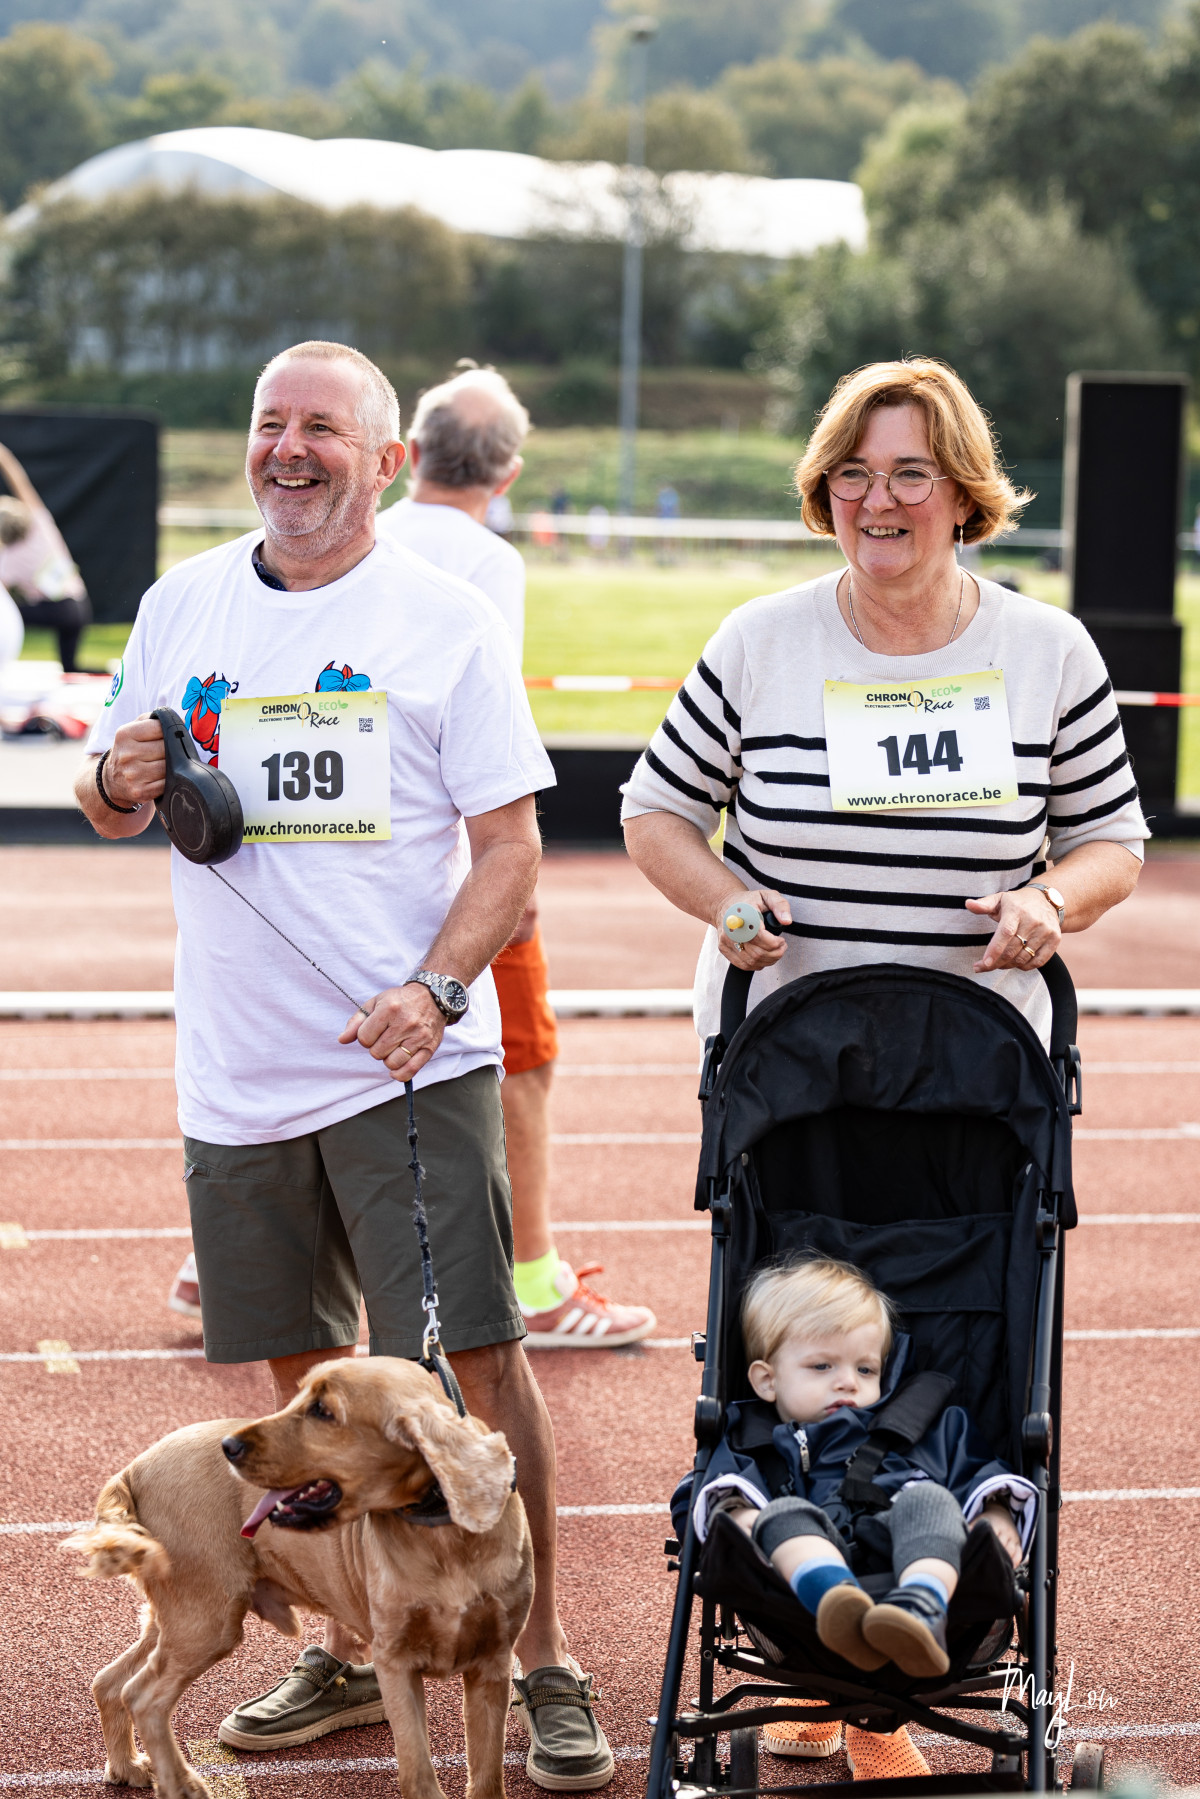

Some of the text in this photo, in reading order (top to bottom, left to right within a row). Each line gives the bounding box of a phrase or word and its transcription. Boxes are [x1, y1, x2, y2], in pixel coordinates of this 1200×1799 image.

[924, 699, 955, 714] Race
[310, 711, 340, 729] Race
[877, 729, 964, 776] 144
[261, 750, 344, 802] 139
[847, 787, 1002, 807] www.chronorace.be
